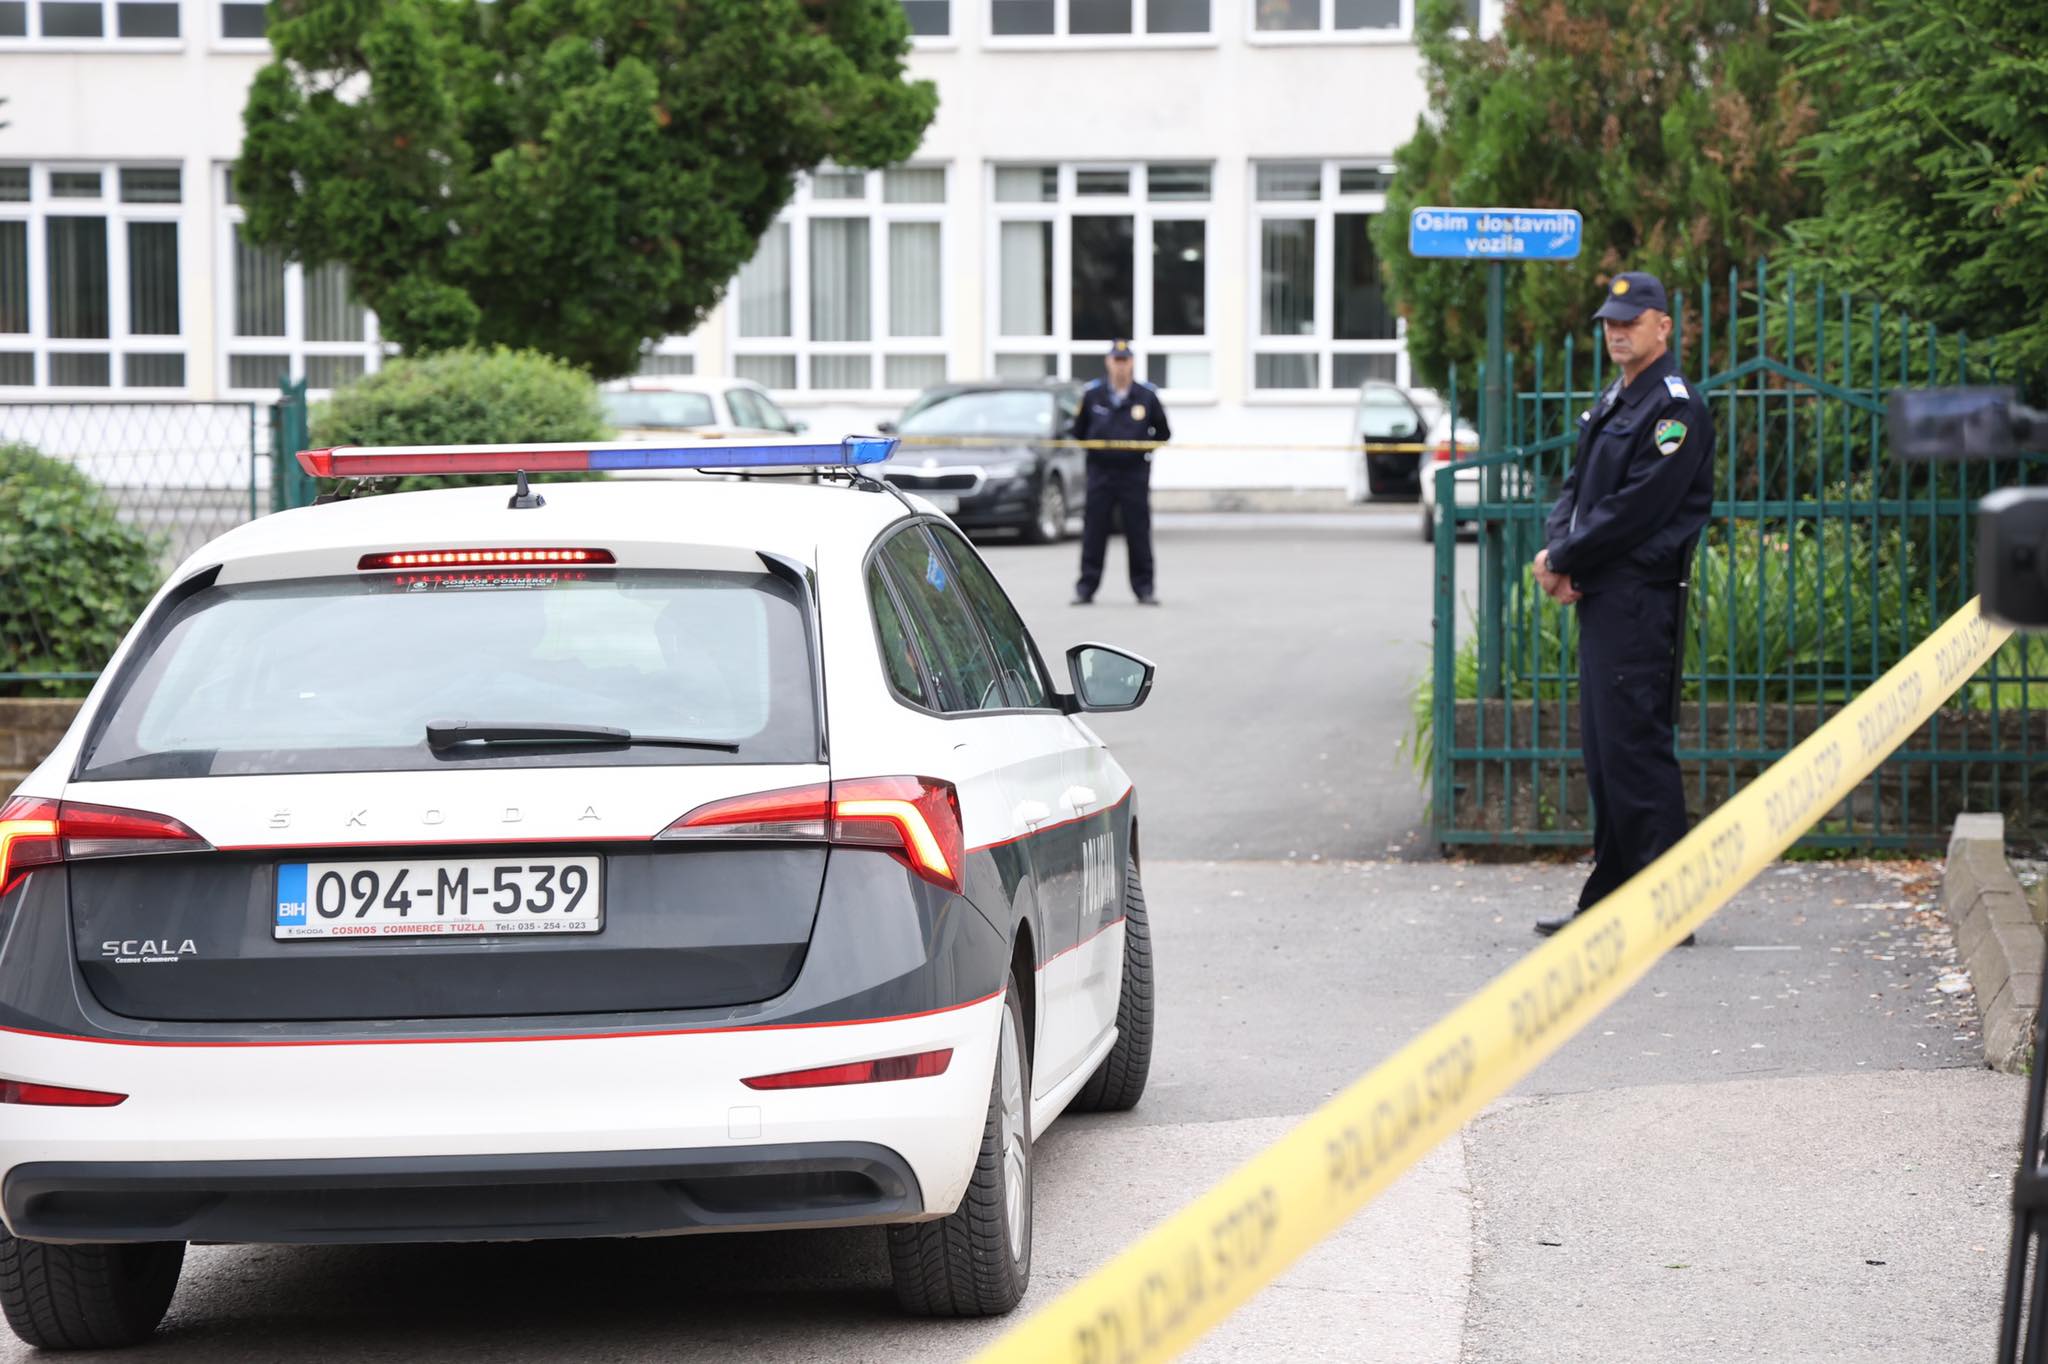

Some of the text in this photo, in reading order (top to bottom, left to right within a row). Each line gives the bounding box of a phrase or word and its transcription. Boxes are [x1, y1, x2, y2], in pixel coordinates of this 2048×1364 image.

[1415, 211, 1576, 234] Osim dostavnih
[1465, 235, 1525, 253] vozila
[316, 864, 588, 919] 094-M-539
[279, 902, 305, 917] BIH
[331, 926, 377, 935] COSMOS
[383, 924, 444, 934] COMMERCE
[450, 923, 485, 932] TUZLA
[517, 922, 535, 931] 035
[543, 922, 560, 930] 254
[568, 921, 586, 930] 023
[101, 939, 197, 956] SCALA
